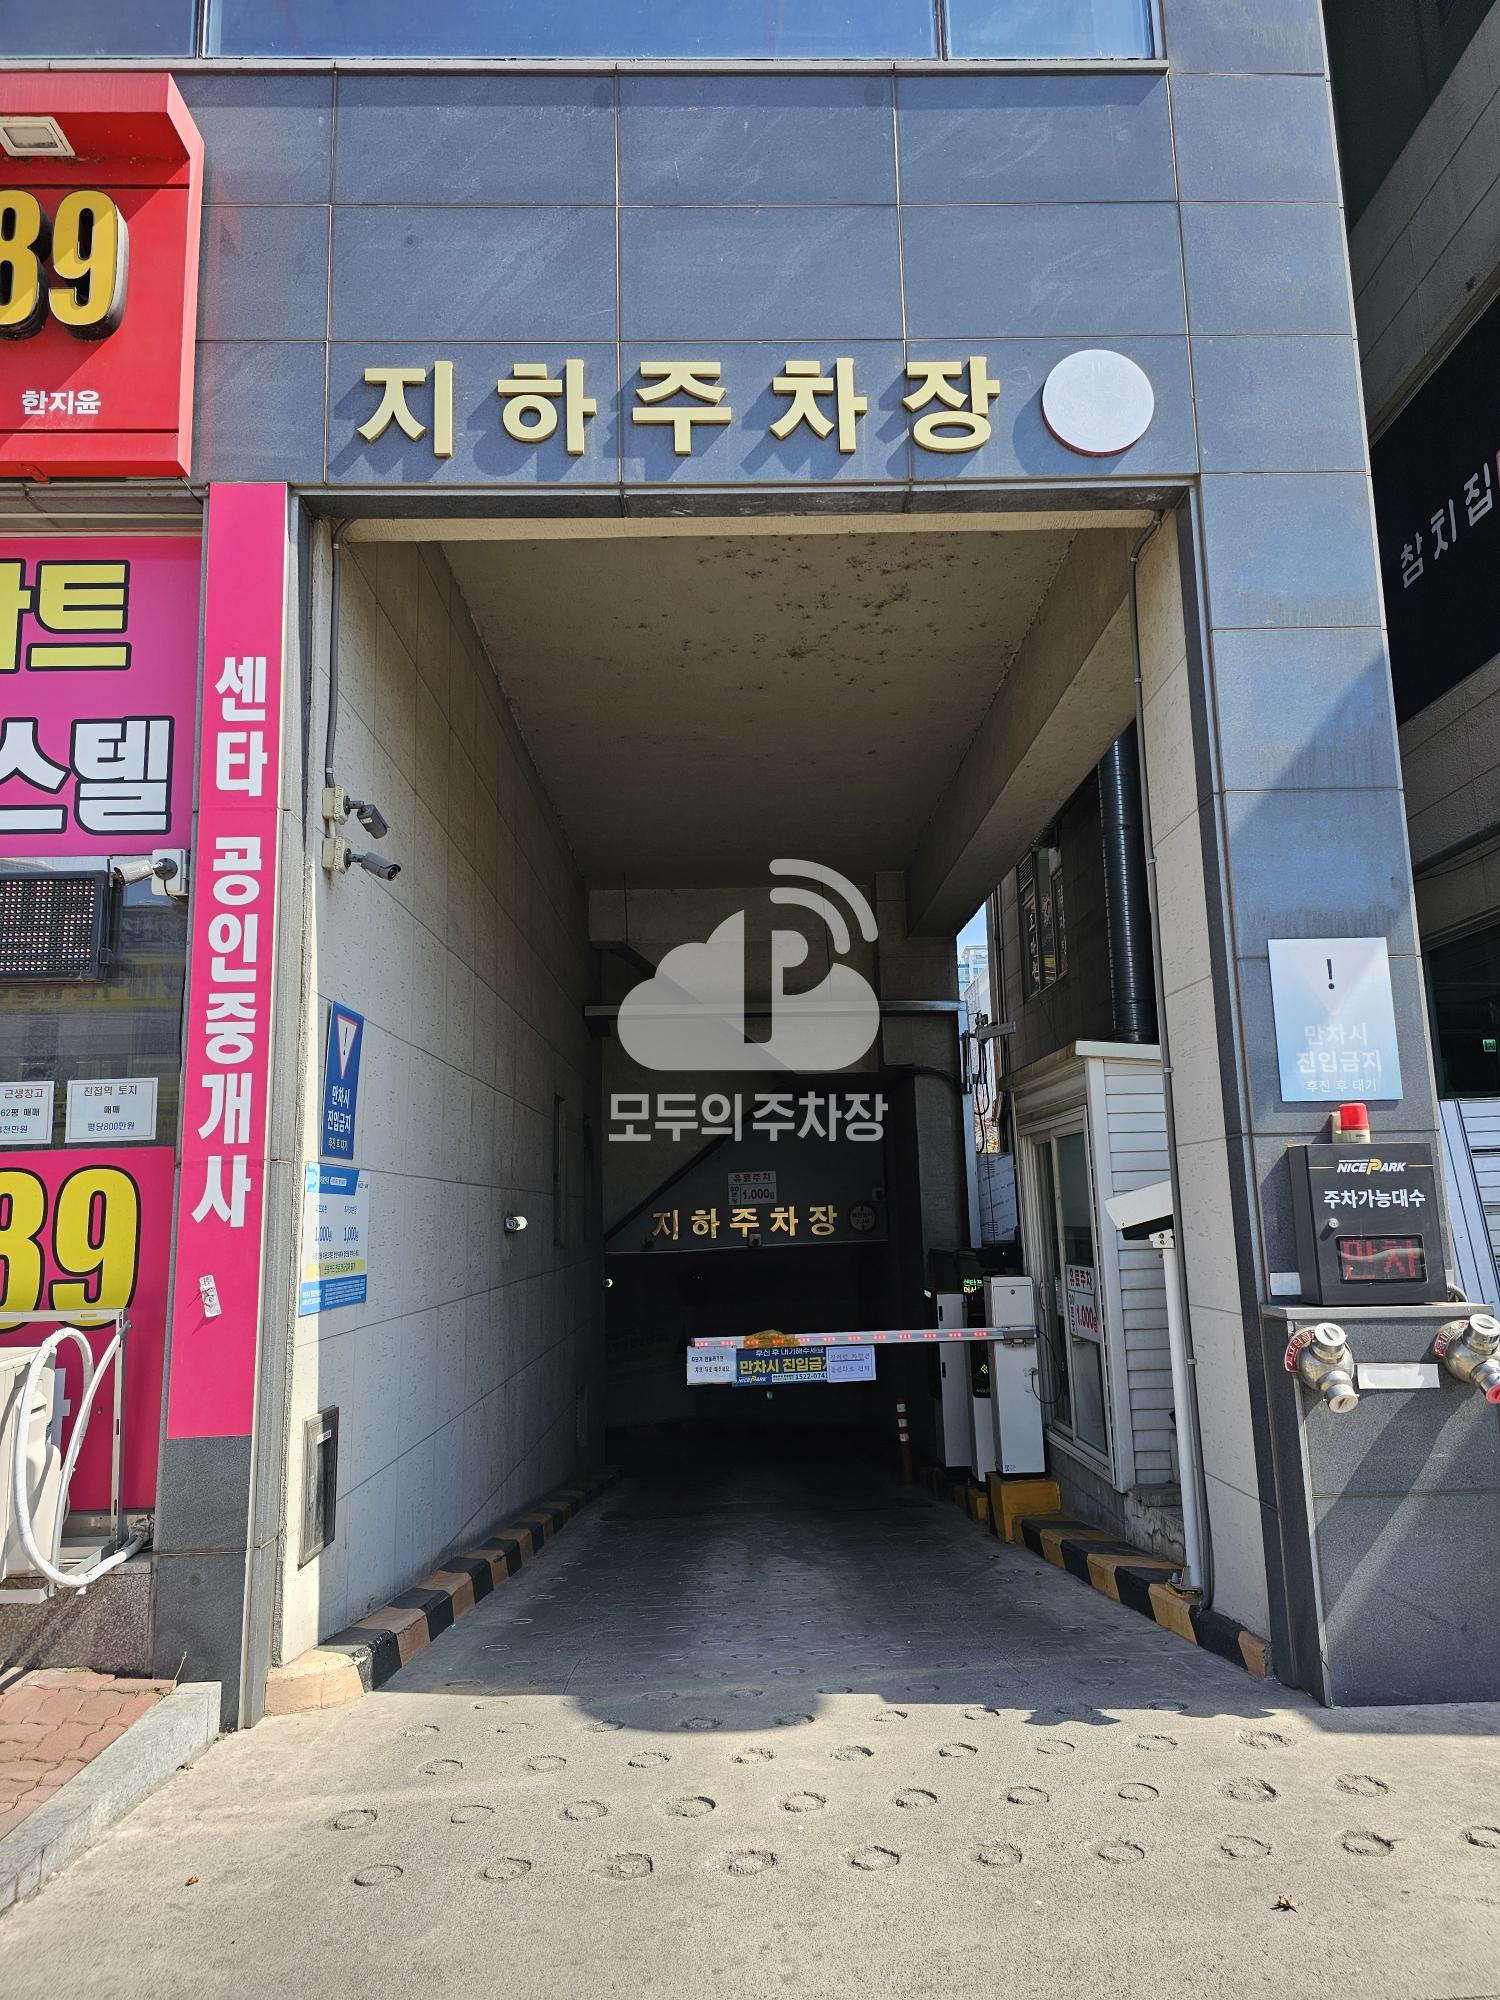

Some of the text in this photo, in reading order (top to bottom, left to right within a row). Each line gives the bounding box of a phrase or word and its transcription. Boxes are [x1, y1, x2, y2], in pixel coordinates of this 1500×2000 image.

[22, 390, 101, 415] 한지윤
[357, 356, 1000, 458] 지하주차장
[191, 656, 267, 1228] 센타 공인중개사
[1304, 1022, 1368, 1049] 만차시
[1295, 1049, 1382, 1073] 진입금지
[118, 1085, 138, 1096] 토지
[331, 1085, 350, 1109] 만차시
[1335, 1079, 1348, 1092] 후
[1352, 1078, 1377, 1093] 대기
[327, 1110, 352, 1135] 진입금지
[1336, 1158, 1407, 1174] NICEPARK
[1323, 1188, 1426, 1209] 주차가능대수
[652, 1205, 838, 1240] 지하주차장
[740, 1359, 779, 1375] 만차시
